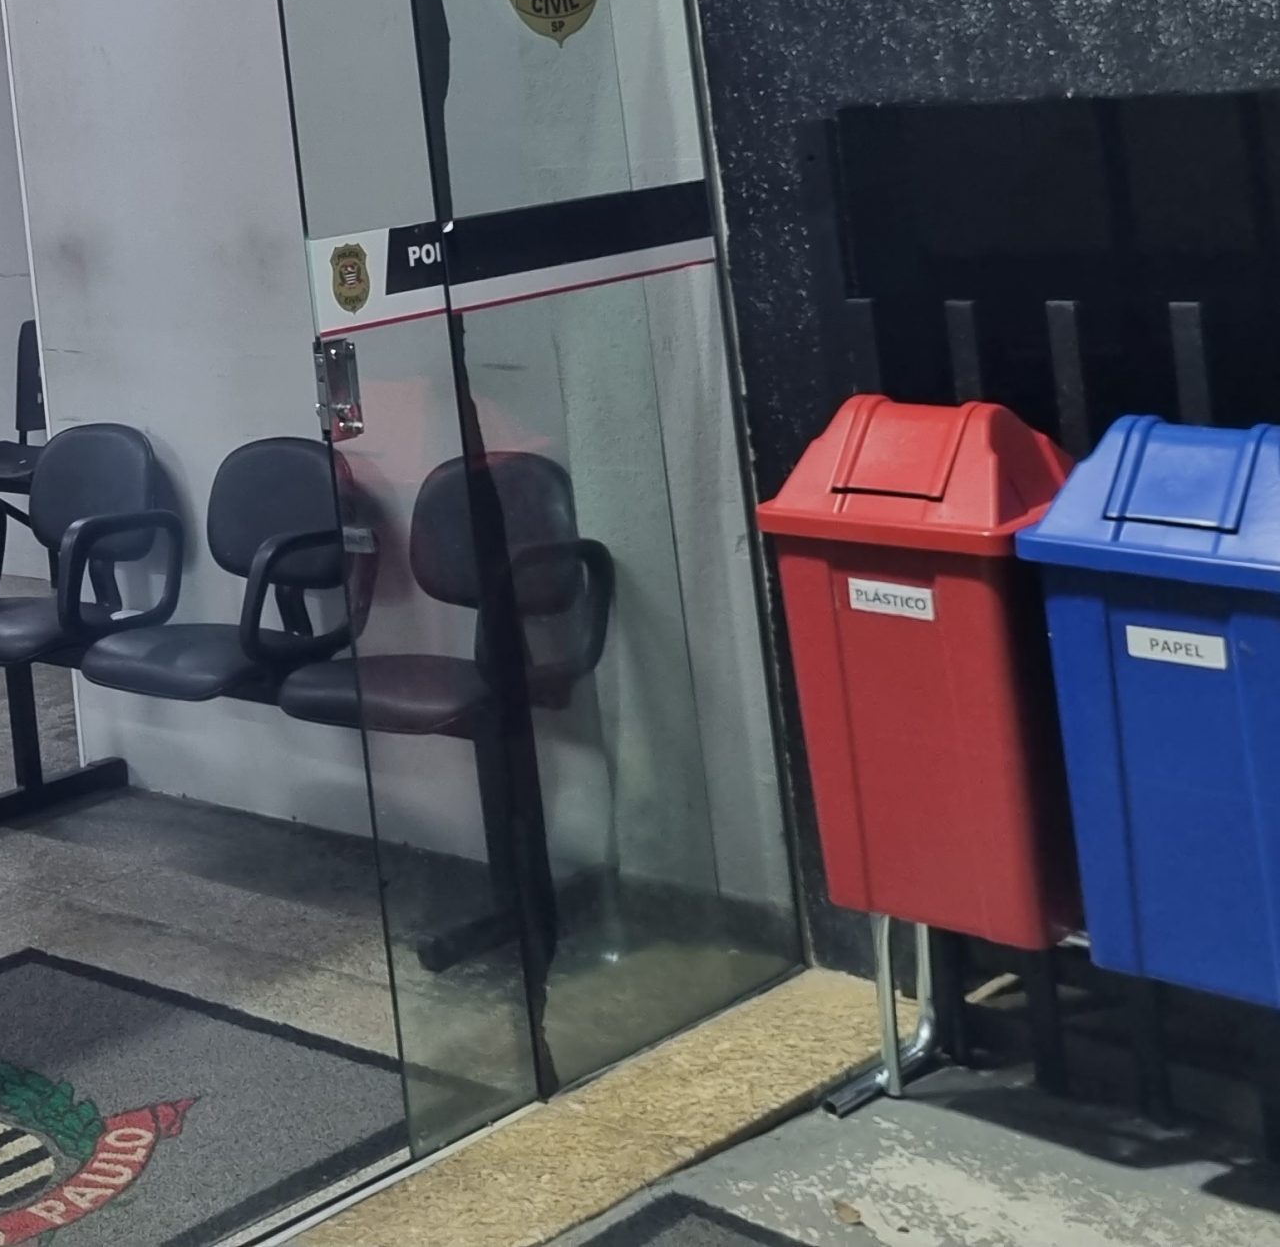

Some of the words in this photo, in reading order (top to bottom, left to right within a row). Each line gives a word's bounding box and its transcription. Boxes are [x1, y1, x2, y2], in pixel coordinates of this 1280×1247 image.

[551, 21, 565, 34] SP
[855, 581, 927, 612] PLÁSTICO
[1149, 637, 1204, 659] PAPEL
[27, 1127, 153, 1225] PAULO
